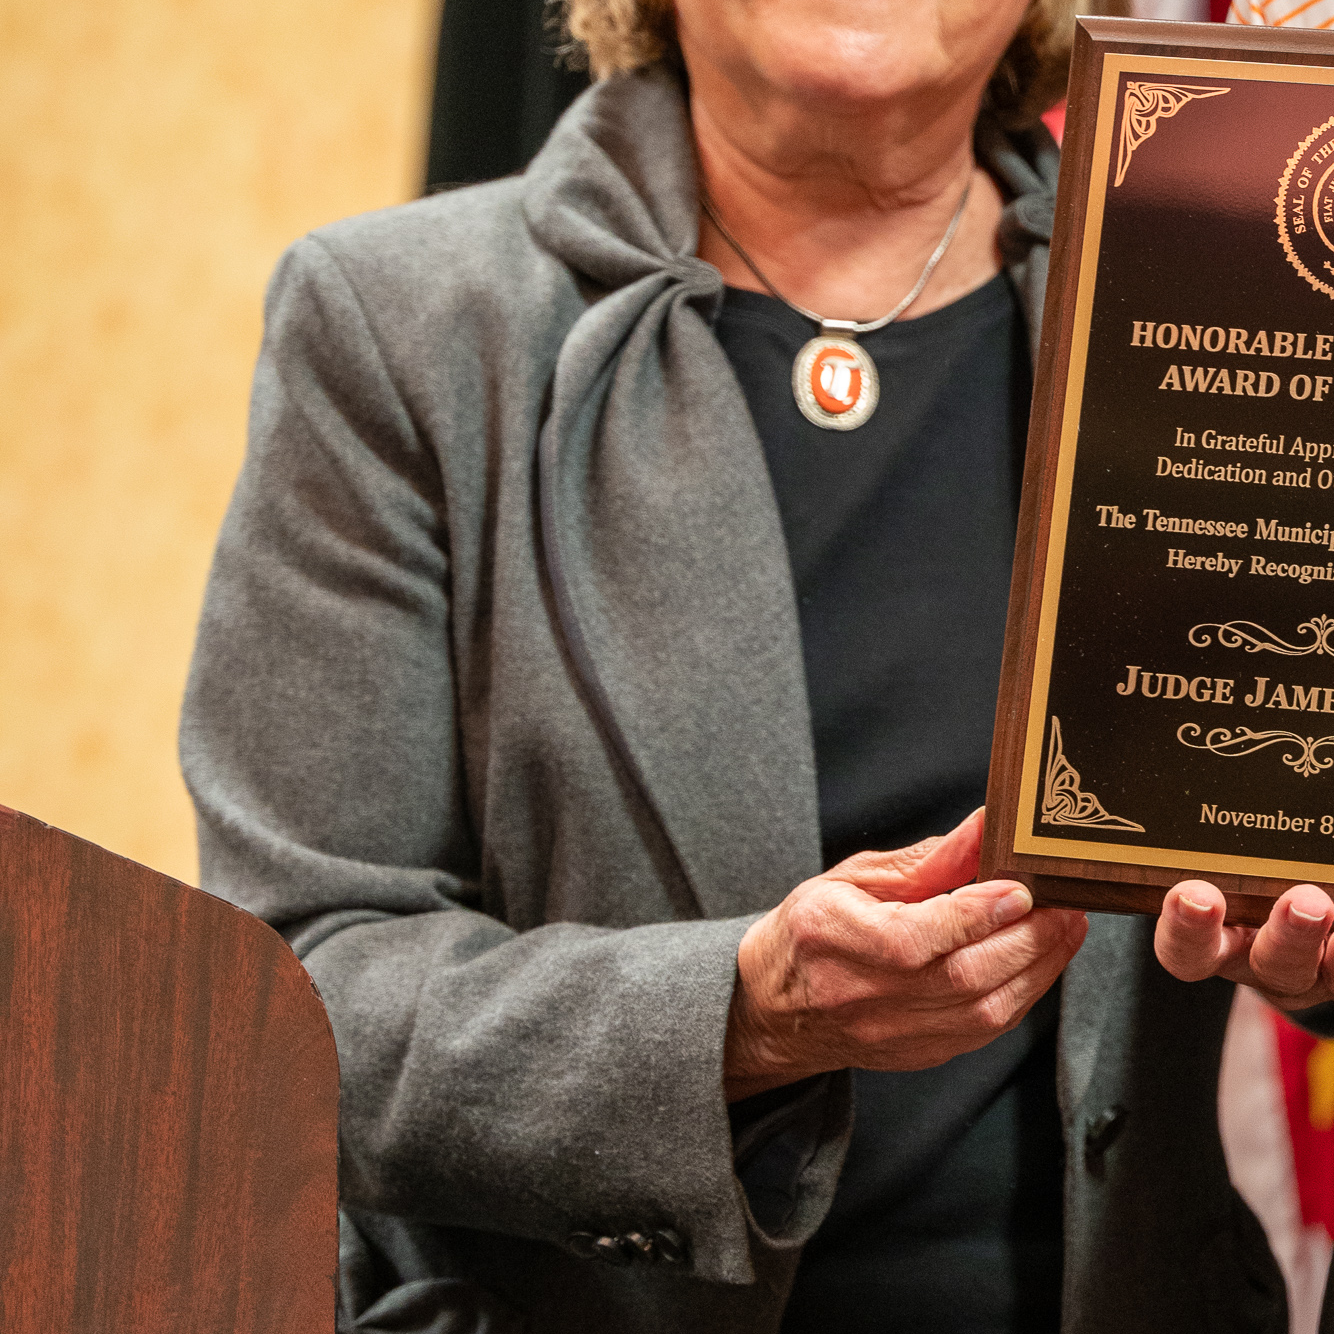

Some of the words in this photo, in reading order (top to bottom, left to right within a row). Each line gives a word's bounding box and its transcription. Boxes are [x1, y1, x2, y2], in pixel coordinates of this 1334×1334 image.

[1297, 167, 1314, 188] OF
[1292, 194, 1307, 234] SEAL
[1323, 197, 1333, 223] FIAT
[1130, 321, 1334, 361] HONORABLE
[1159, 365, 1280, 398] AWARD
[1289, 375, 1333, 403] OF
[1174, 427, 1196, 448] In
[1201, 429, 1285, 455] Grateful
[1156, 456, 1267, 485] Dedication
[1272, 468, 1311, 488] and
[1096, 505, 1136, 529] The
[1143, 509, 1248, 539] Tennessee
[1166, 548, 1243, 577] Hereby
[1200, 803, 1315, 834] November
